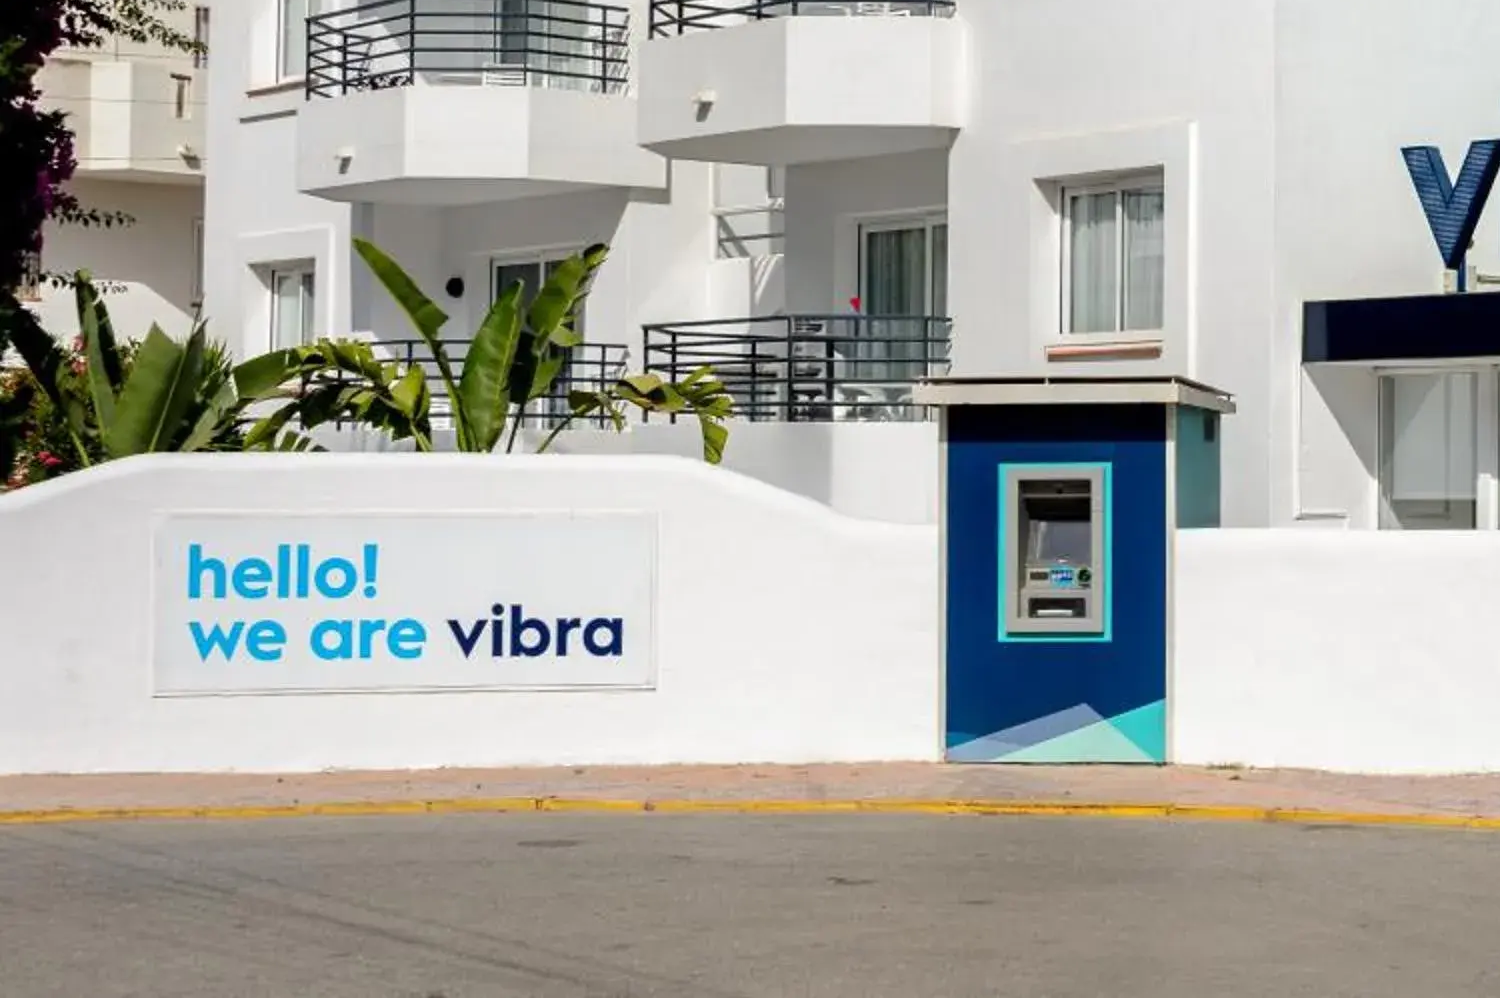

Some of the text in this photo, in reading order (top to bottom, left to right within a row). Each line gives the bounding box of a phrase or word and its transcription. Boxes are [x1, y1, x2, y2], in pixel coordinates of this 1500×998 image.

[187, 544, 378, 599] hello!
[187, 603, 624, 662] we are vibra
